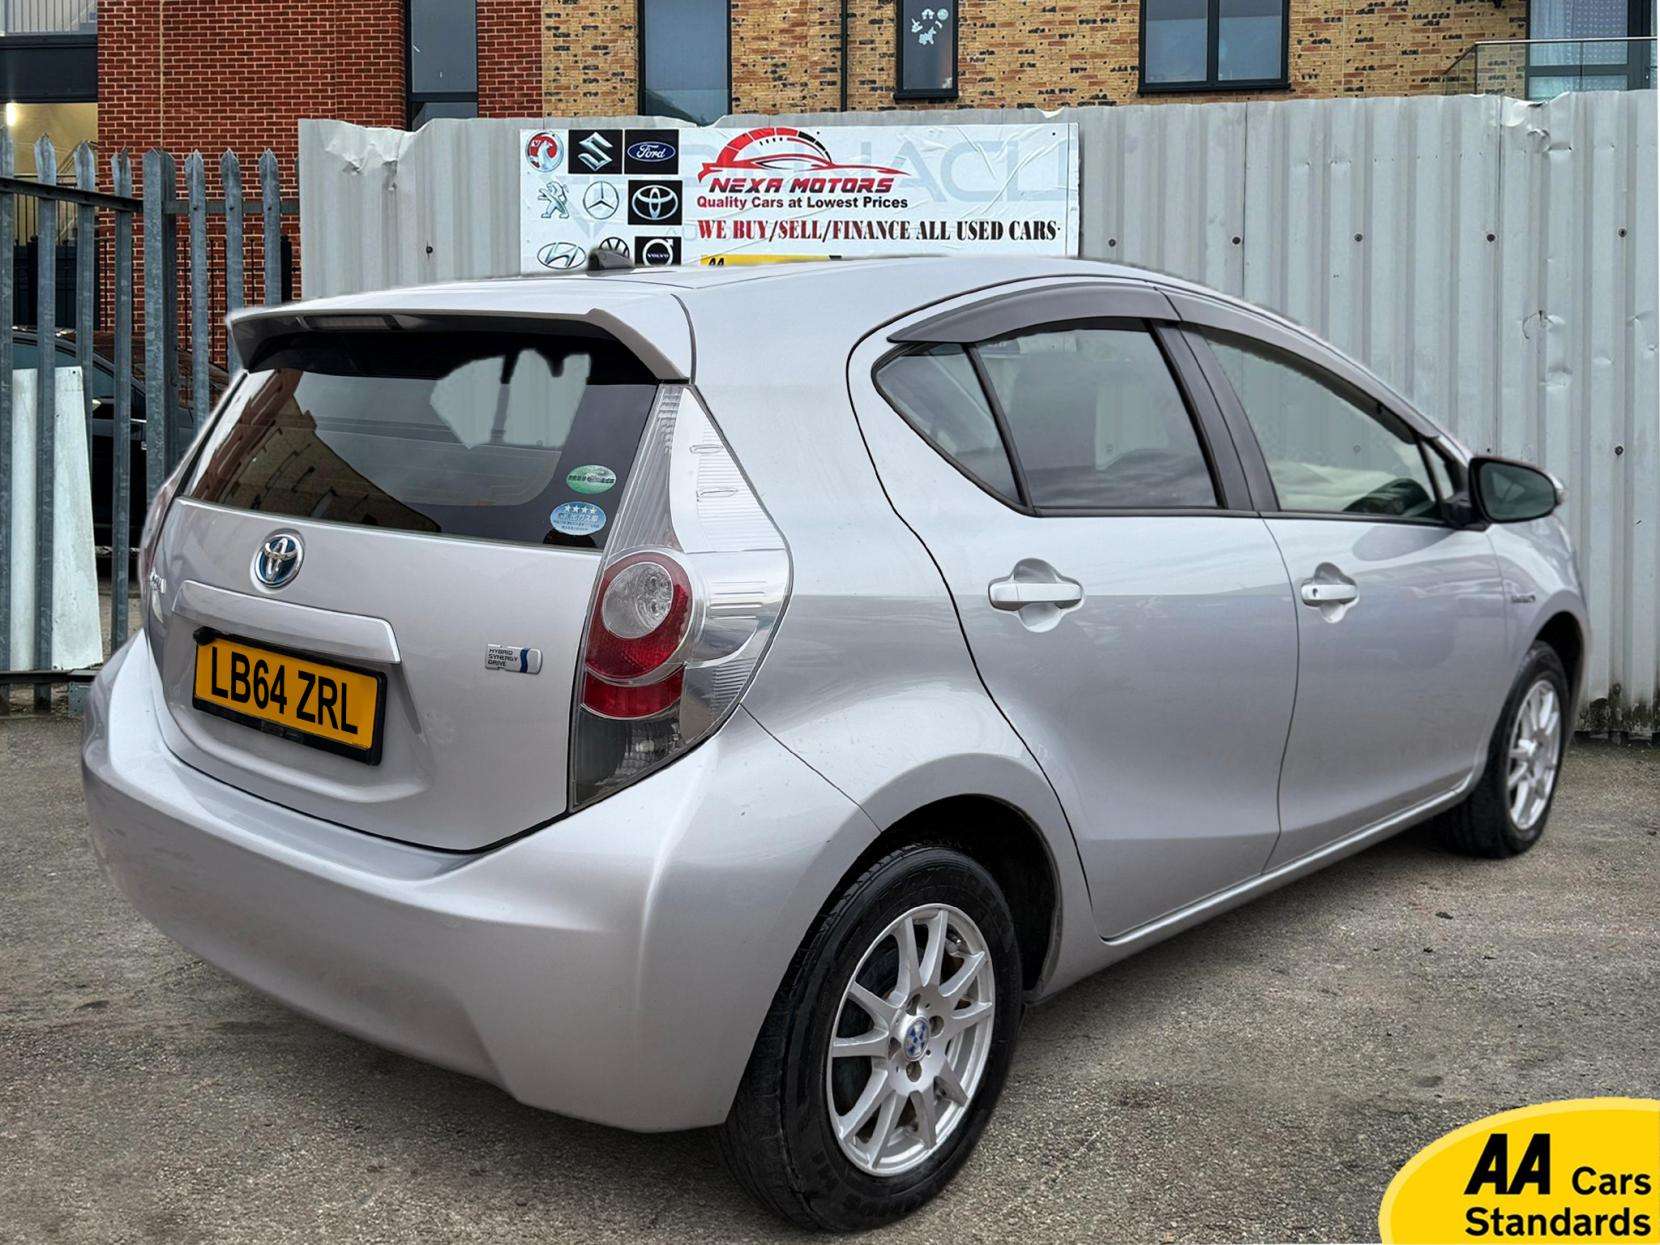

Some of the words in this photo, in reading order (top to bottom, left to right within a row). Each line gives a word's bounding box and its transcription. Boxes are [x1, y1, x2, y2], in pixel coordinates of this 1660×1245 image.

[636, 144, 667, 159] Ford
[708, 177, 784, 193] NEXA
[789, 177, 895, 193] MOTORS
[697, 196, 748, 210] Quality
[752, 196, 784, 209] Cars
[788, 197, 802, 209] at
[807, 196, 858, 209] Lowest
[863, 196, 908, 209] Prices
[697, 219, 727, 240] WE
[916, 220, 951, 240] ALL
[956, 220, 1004, 240] USED
[1008, 220, 1057, 240] CARS
[211, 646, 288, 715] LB64
[296, 669, 358, 735] ZRL
